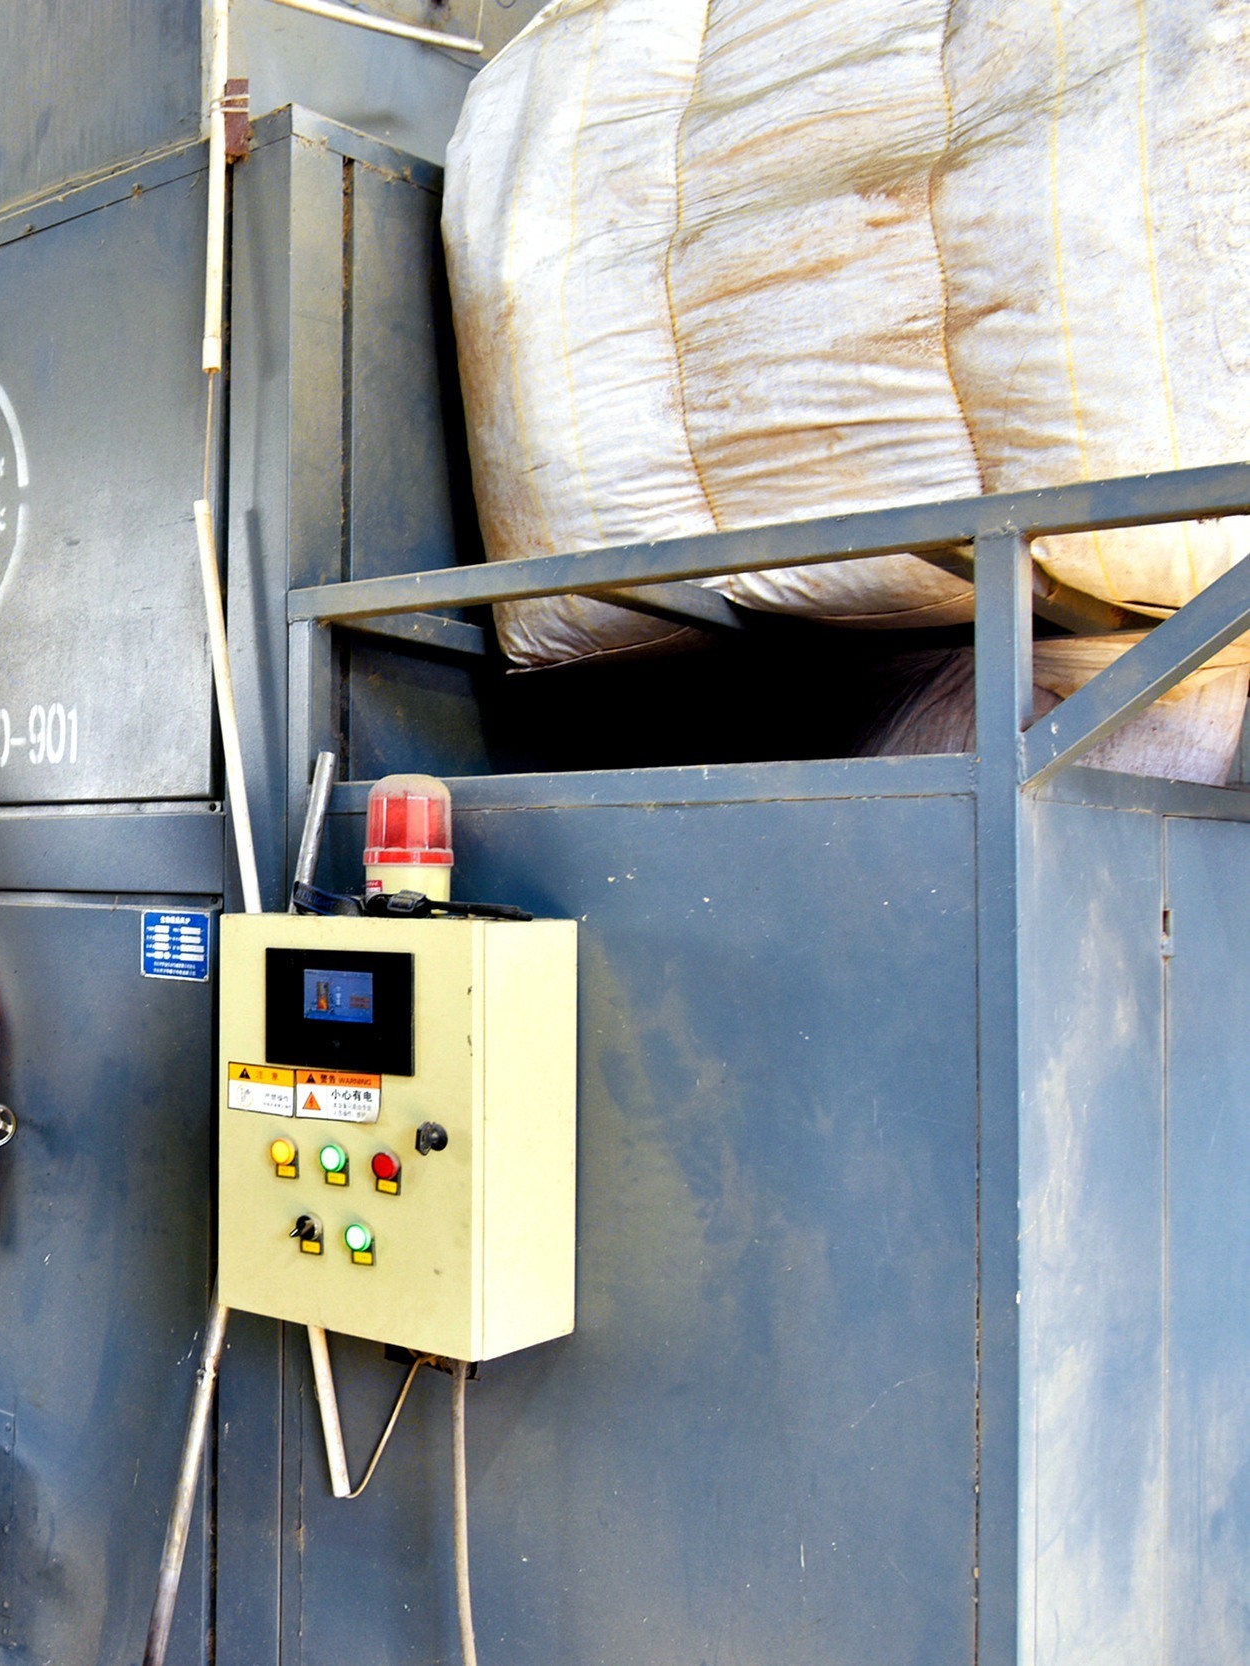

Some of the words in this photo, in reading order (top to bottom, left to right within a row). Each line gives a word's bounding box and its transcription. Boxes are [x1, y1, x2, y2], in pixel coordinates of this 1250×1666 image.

[320, 1073, 337, 1085] 警告
[338, 1077, 372, 1087] WARNING
[331, 1088, 373, 1103] 小心有电
